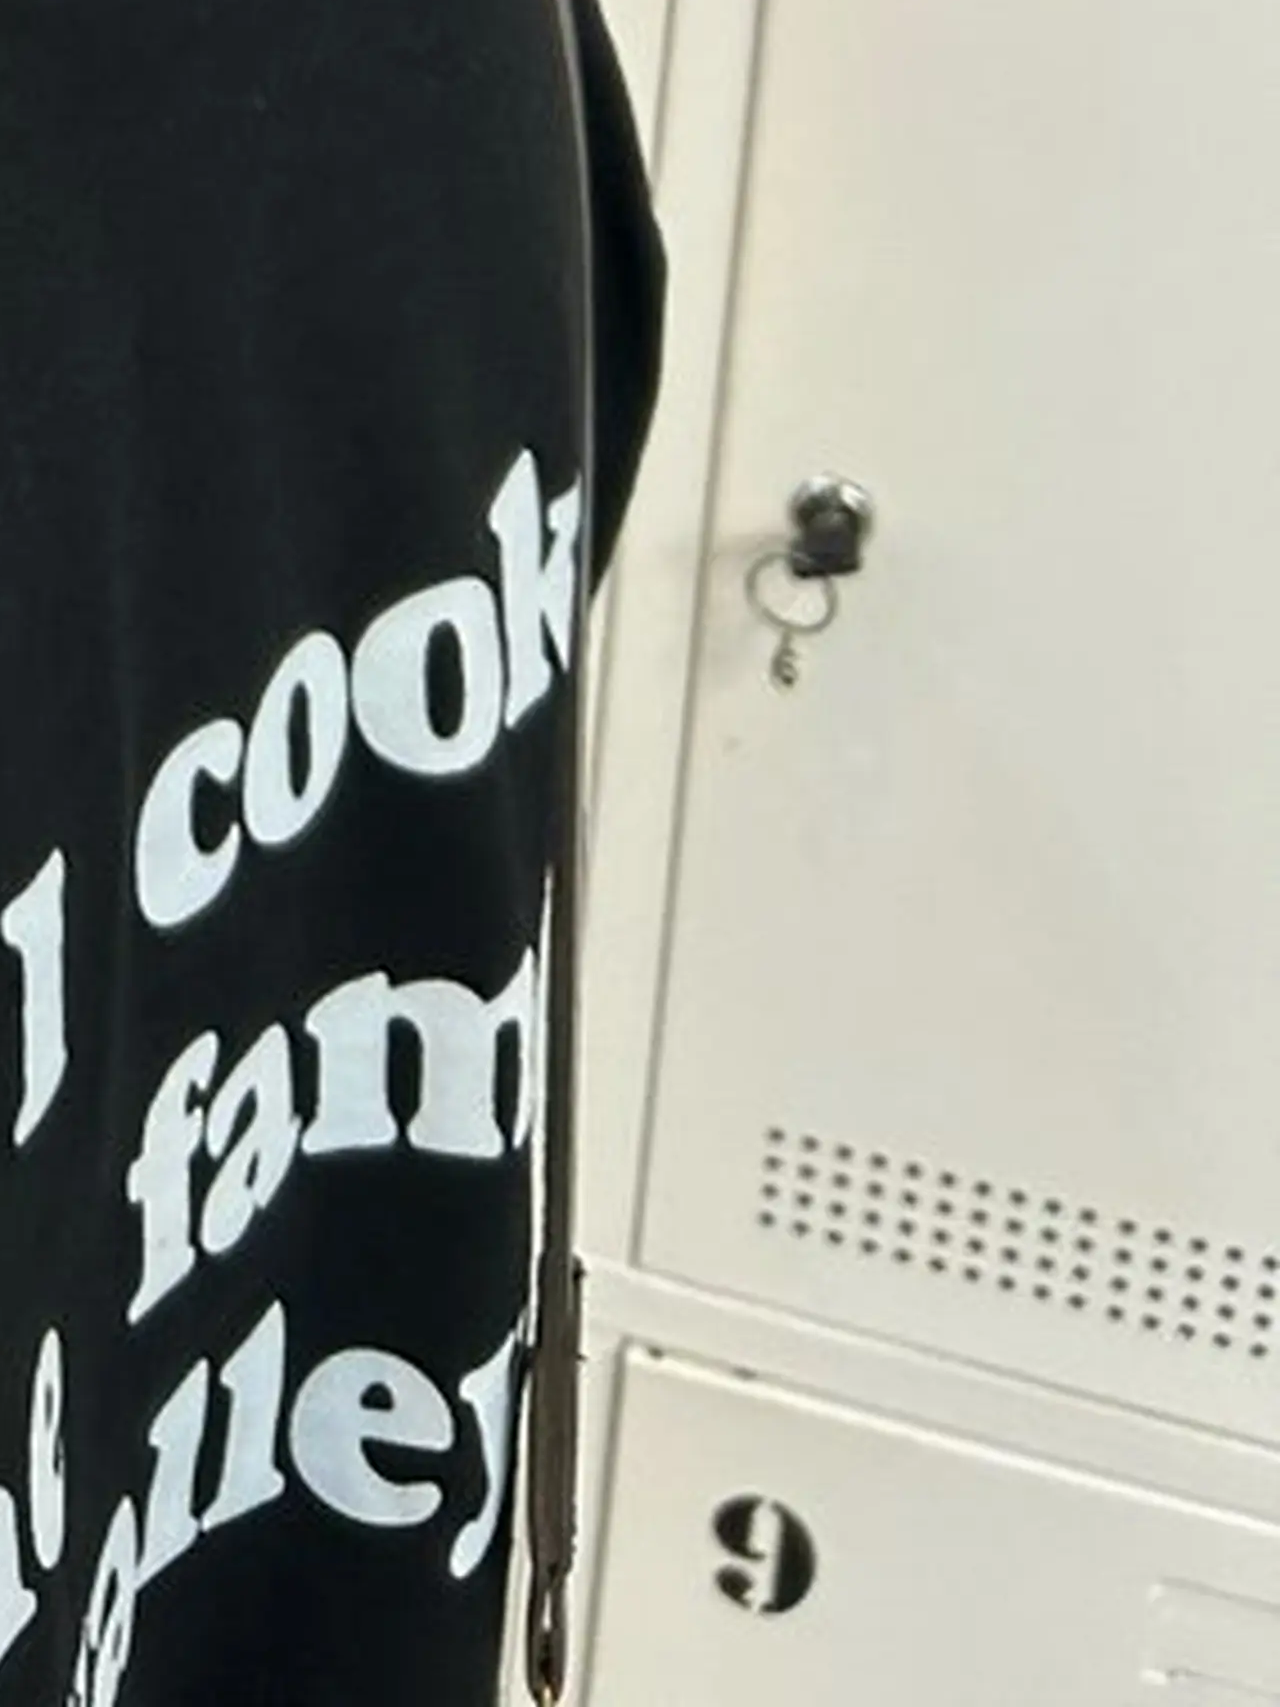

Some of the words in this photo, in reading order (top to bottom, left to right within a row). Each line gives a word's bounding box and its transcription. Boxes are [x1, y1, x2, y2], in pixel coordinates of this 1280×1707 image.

[134, 447, 582, 929] cook
[126, 872, 552, 1327] fam
[711, 1494, 817, 1615] 9
